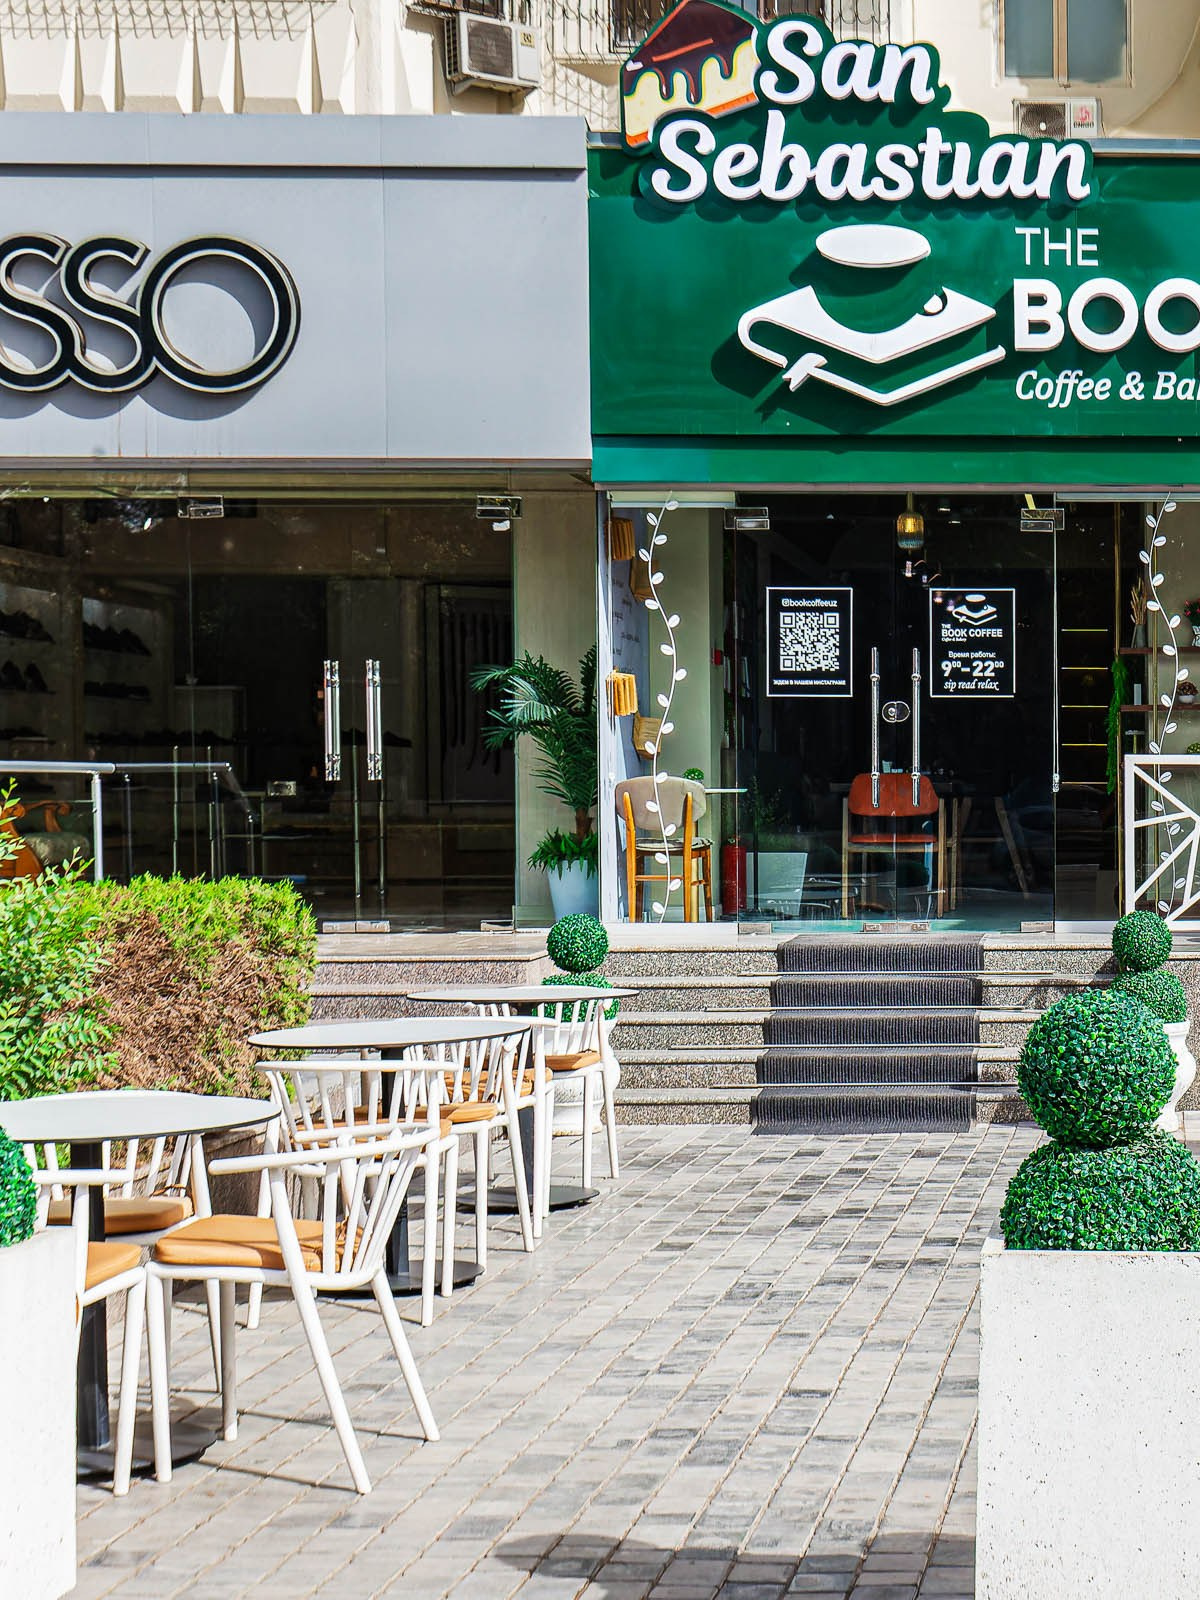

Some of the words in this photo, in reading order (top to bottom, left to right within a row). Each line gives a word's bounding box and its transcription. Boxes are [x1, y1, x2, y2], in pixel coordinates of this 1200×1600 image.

[759, 19, 936, 105] San
[1015, 228, 1099, 266] THE
[1015, 370, 1112, 408] Coffee
[1119, 372, 1145, 401] &
[941, 628, 967, 637] BOOK
[968, 628, 1003, 637] COFFEE
[948, 651, 970, 659] Время
[943, 679, 957, 692] sip
[958, 678, 978, 690] read
[978, 678, 1000, 691] relax
